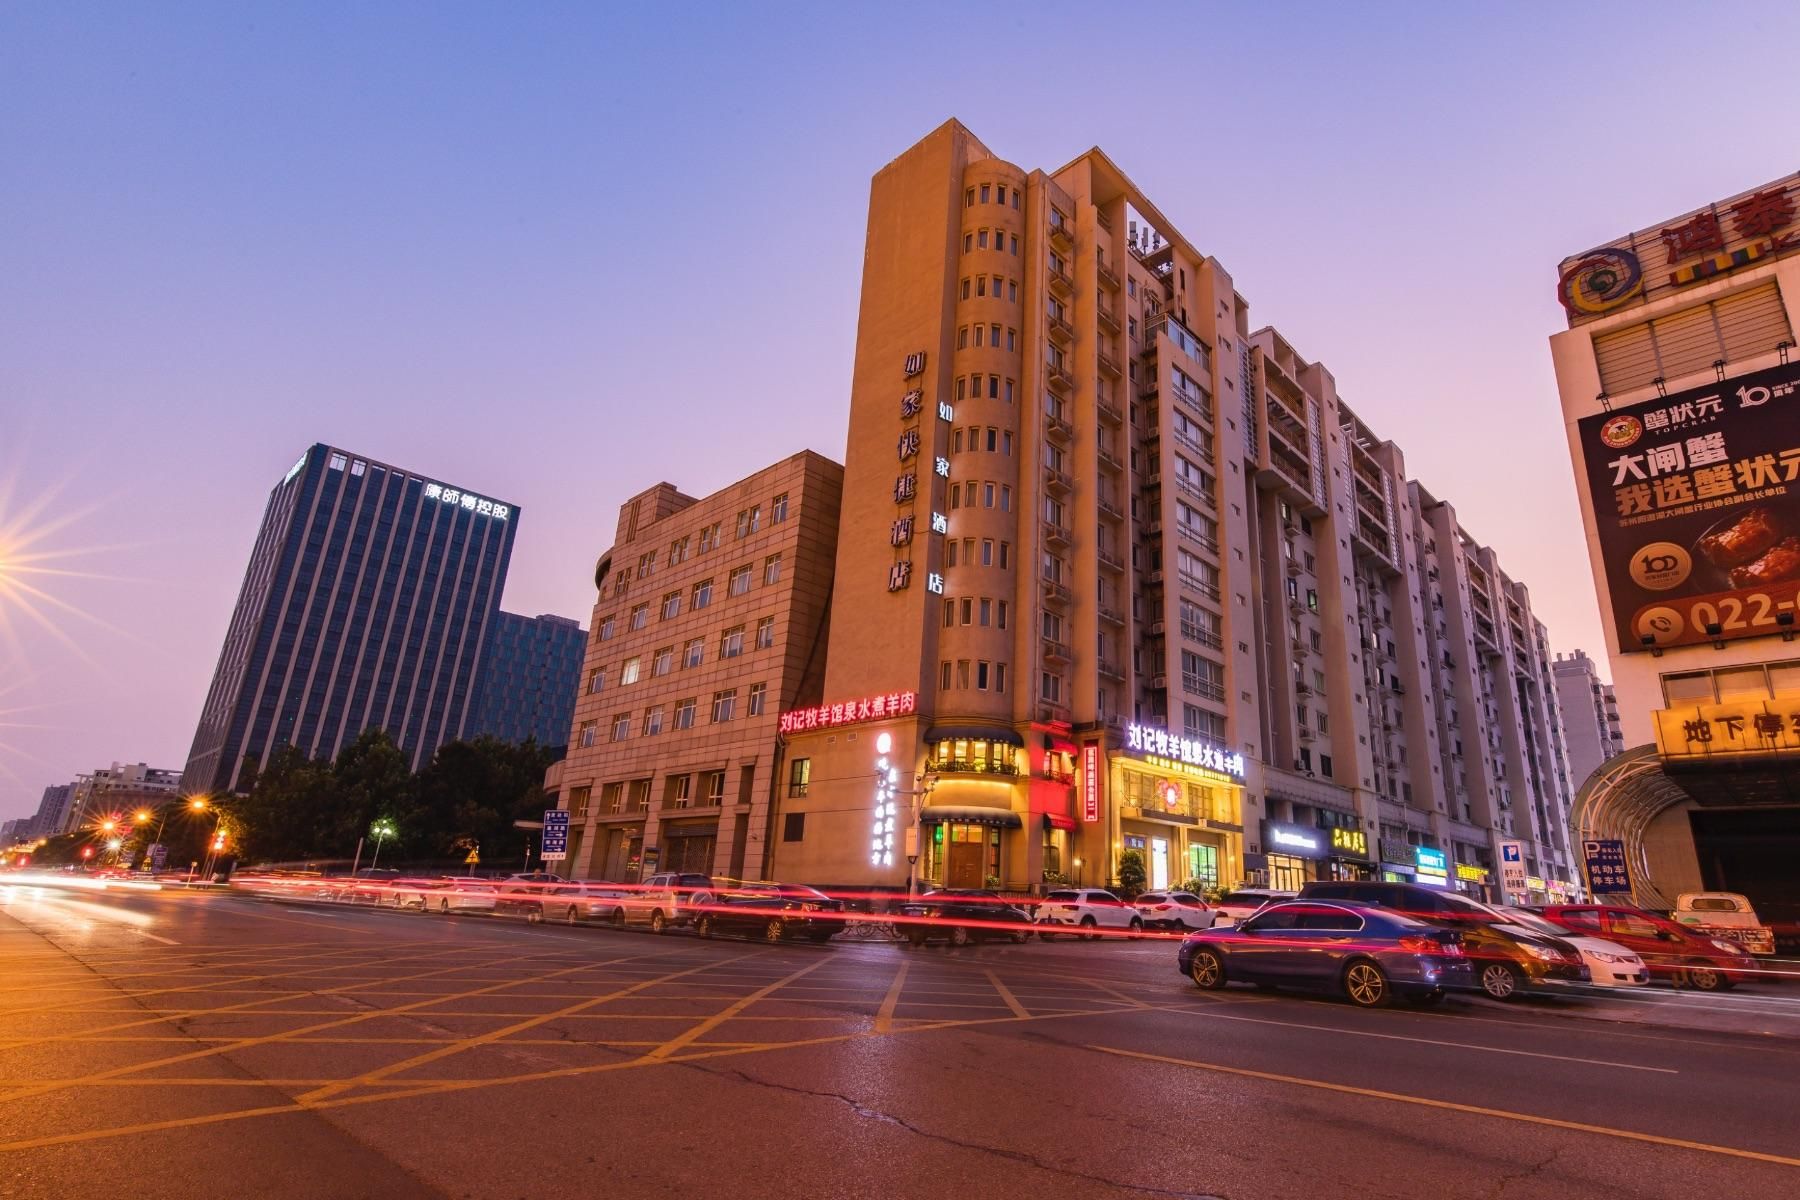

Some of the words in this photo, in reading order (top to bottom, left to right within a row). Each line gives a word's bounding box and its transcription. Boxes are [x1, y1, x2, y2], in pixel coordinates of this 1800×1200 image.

[1643, 395, 1724, 431] 蟹状元
[888, 352, 926, 592] 如家快捷酒店
[1608, 431, 1728, 486] 大闸蟹
[928, 401, 953, 594] 如家酒店
[1690, 590, 1800, 634] 022-
[780, 691, 914, 732] 刘记牧羊馆泉水煮羊肉
[1591, 865, 1625, 874] 机动车
[1593, 876, 1627, 885] 停车场
